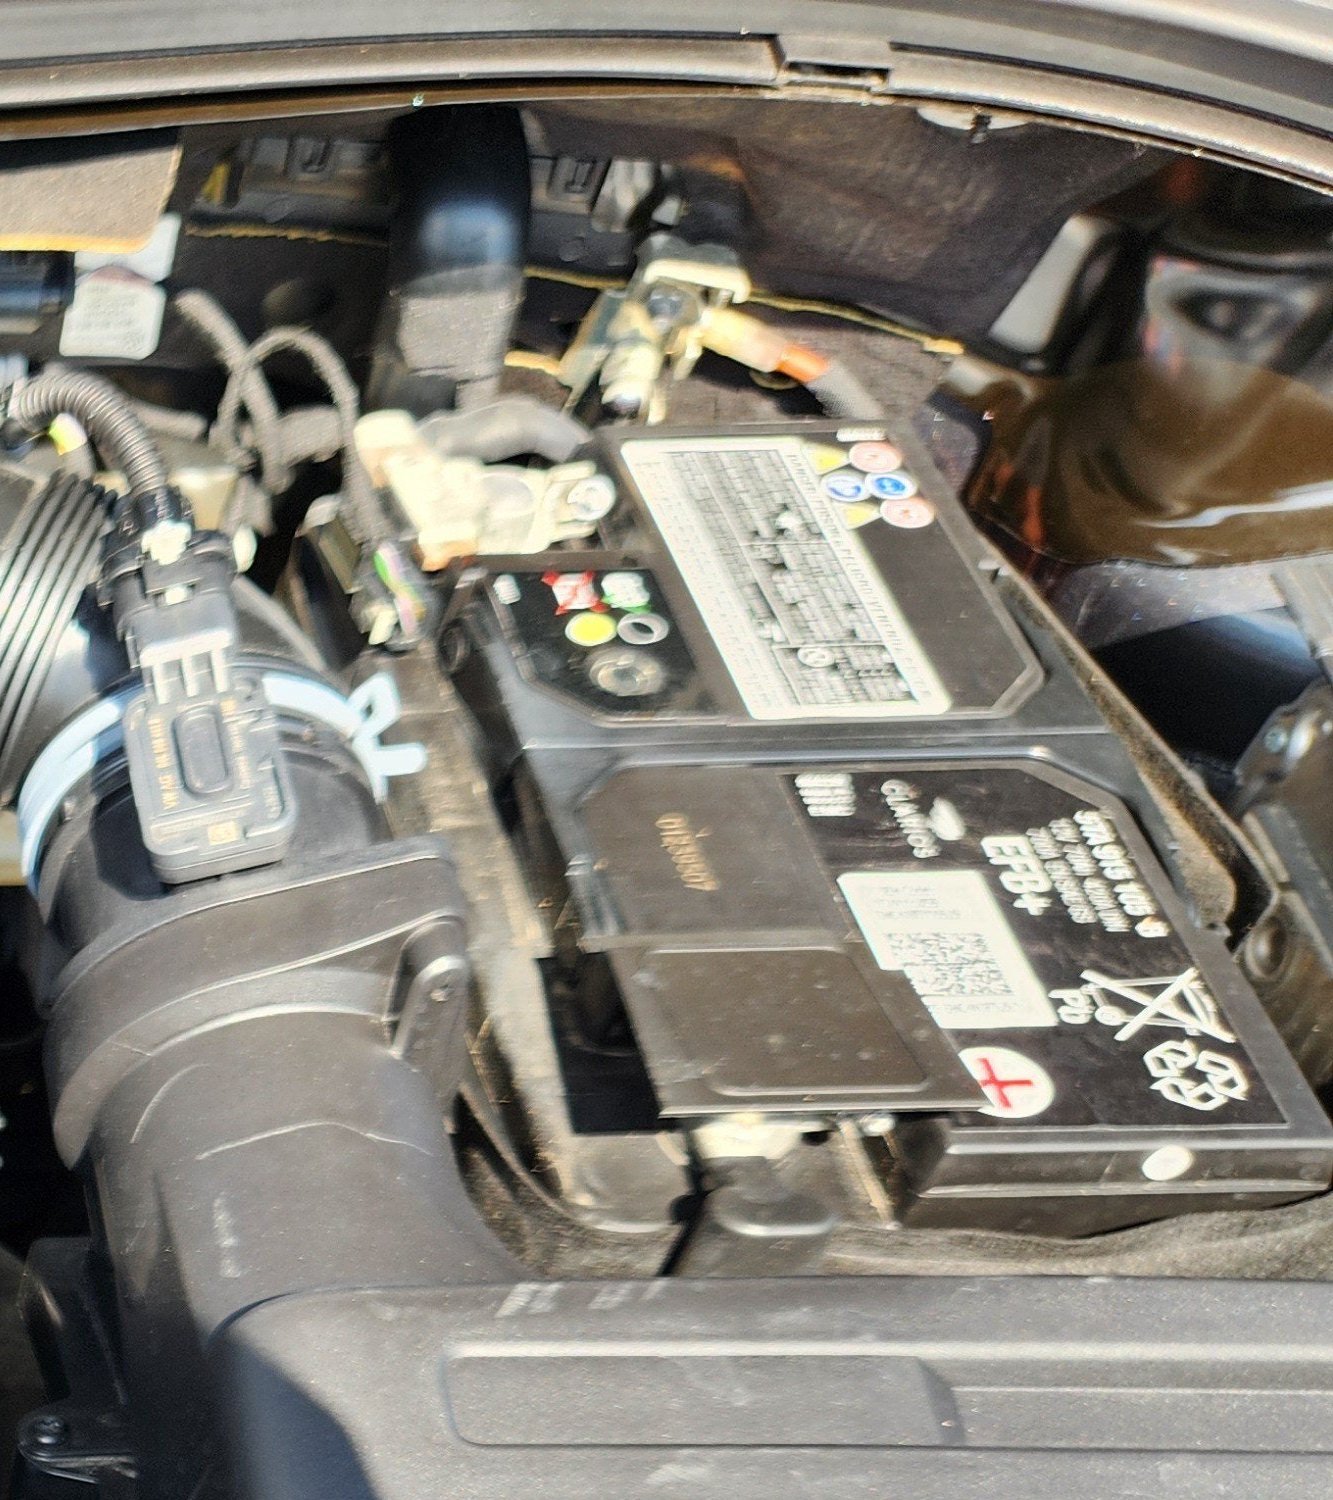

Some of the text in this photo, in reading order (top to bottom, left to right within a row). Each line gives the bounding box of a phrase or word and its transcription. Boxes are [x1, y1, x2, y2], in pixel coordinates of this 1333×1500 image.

[881, 779, 942, 859] CLARIOS
[980, 835, 1053, 916] EFB+
[1048, 989, 1095, 1024] Pb
